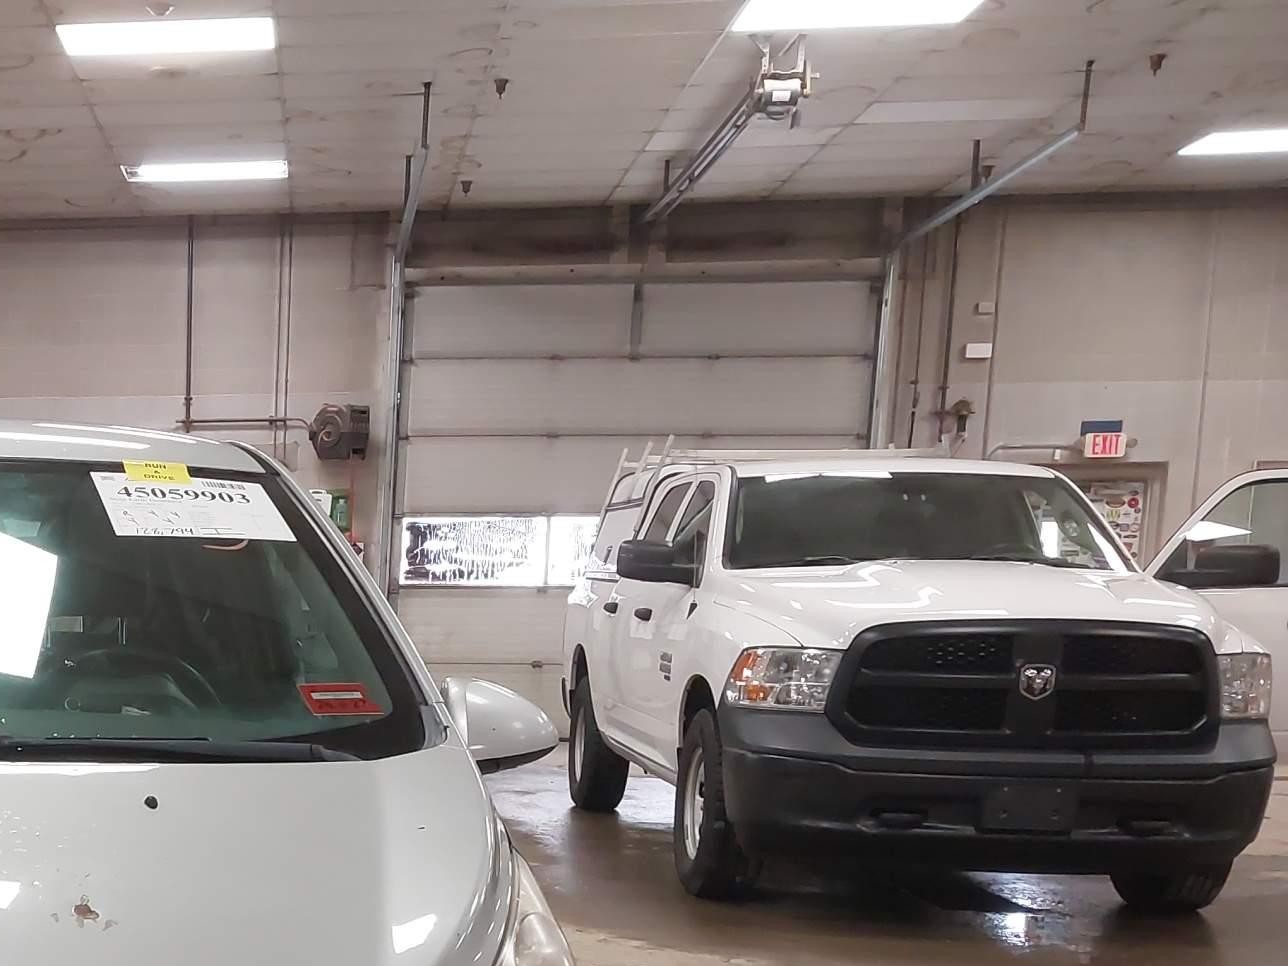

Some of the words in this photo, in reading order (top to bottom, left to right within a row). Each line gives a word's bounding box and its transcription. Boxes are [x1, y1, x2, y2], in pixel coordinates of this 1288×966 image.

[1092, 434, 1121, 455] EXIT
[143, 473, 176, 481] DRIVE
[117, 485, 251, 505] 45059903
